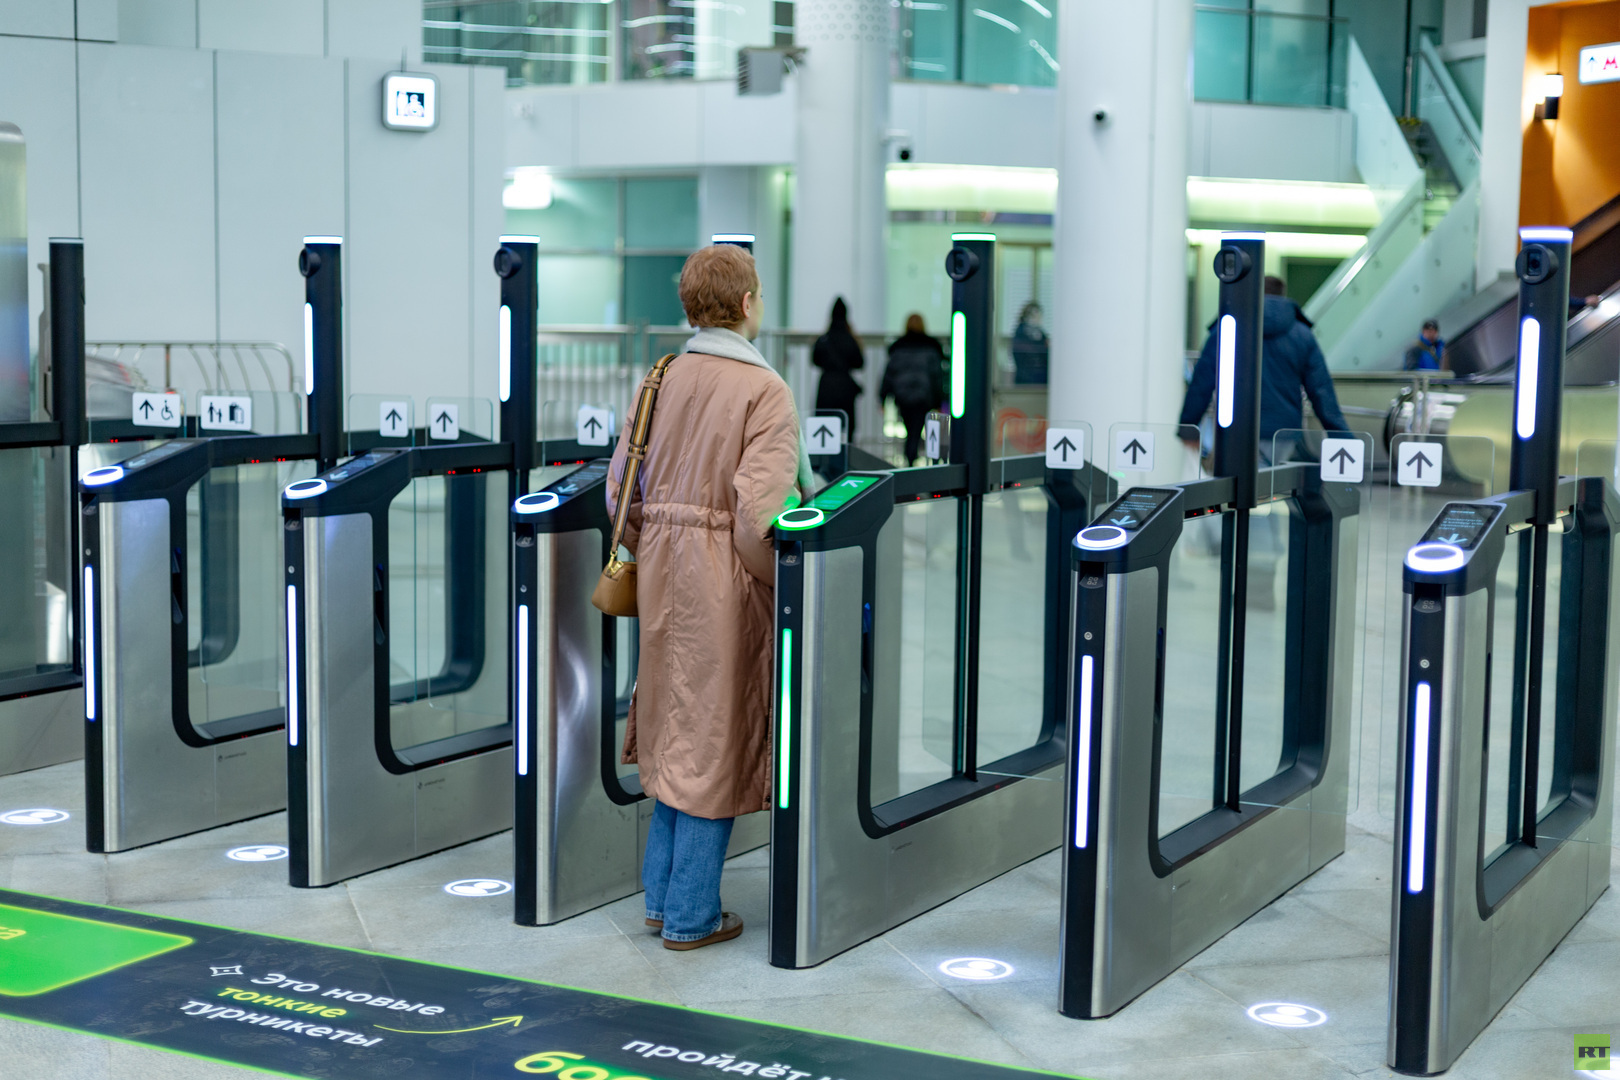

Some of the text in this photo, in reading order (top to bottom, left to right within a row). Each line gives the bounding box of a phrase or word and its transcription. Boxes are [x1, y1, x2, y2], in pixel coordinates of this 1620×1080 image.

[217, 987, 347, 1018] тонкие
[250, 973, 445, 1016] Это новые
[180, 1000, 383, 1047] турникеты
[622, 1040, 811, 1080] пройдёт
